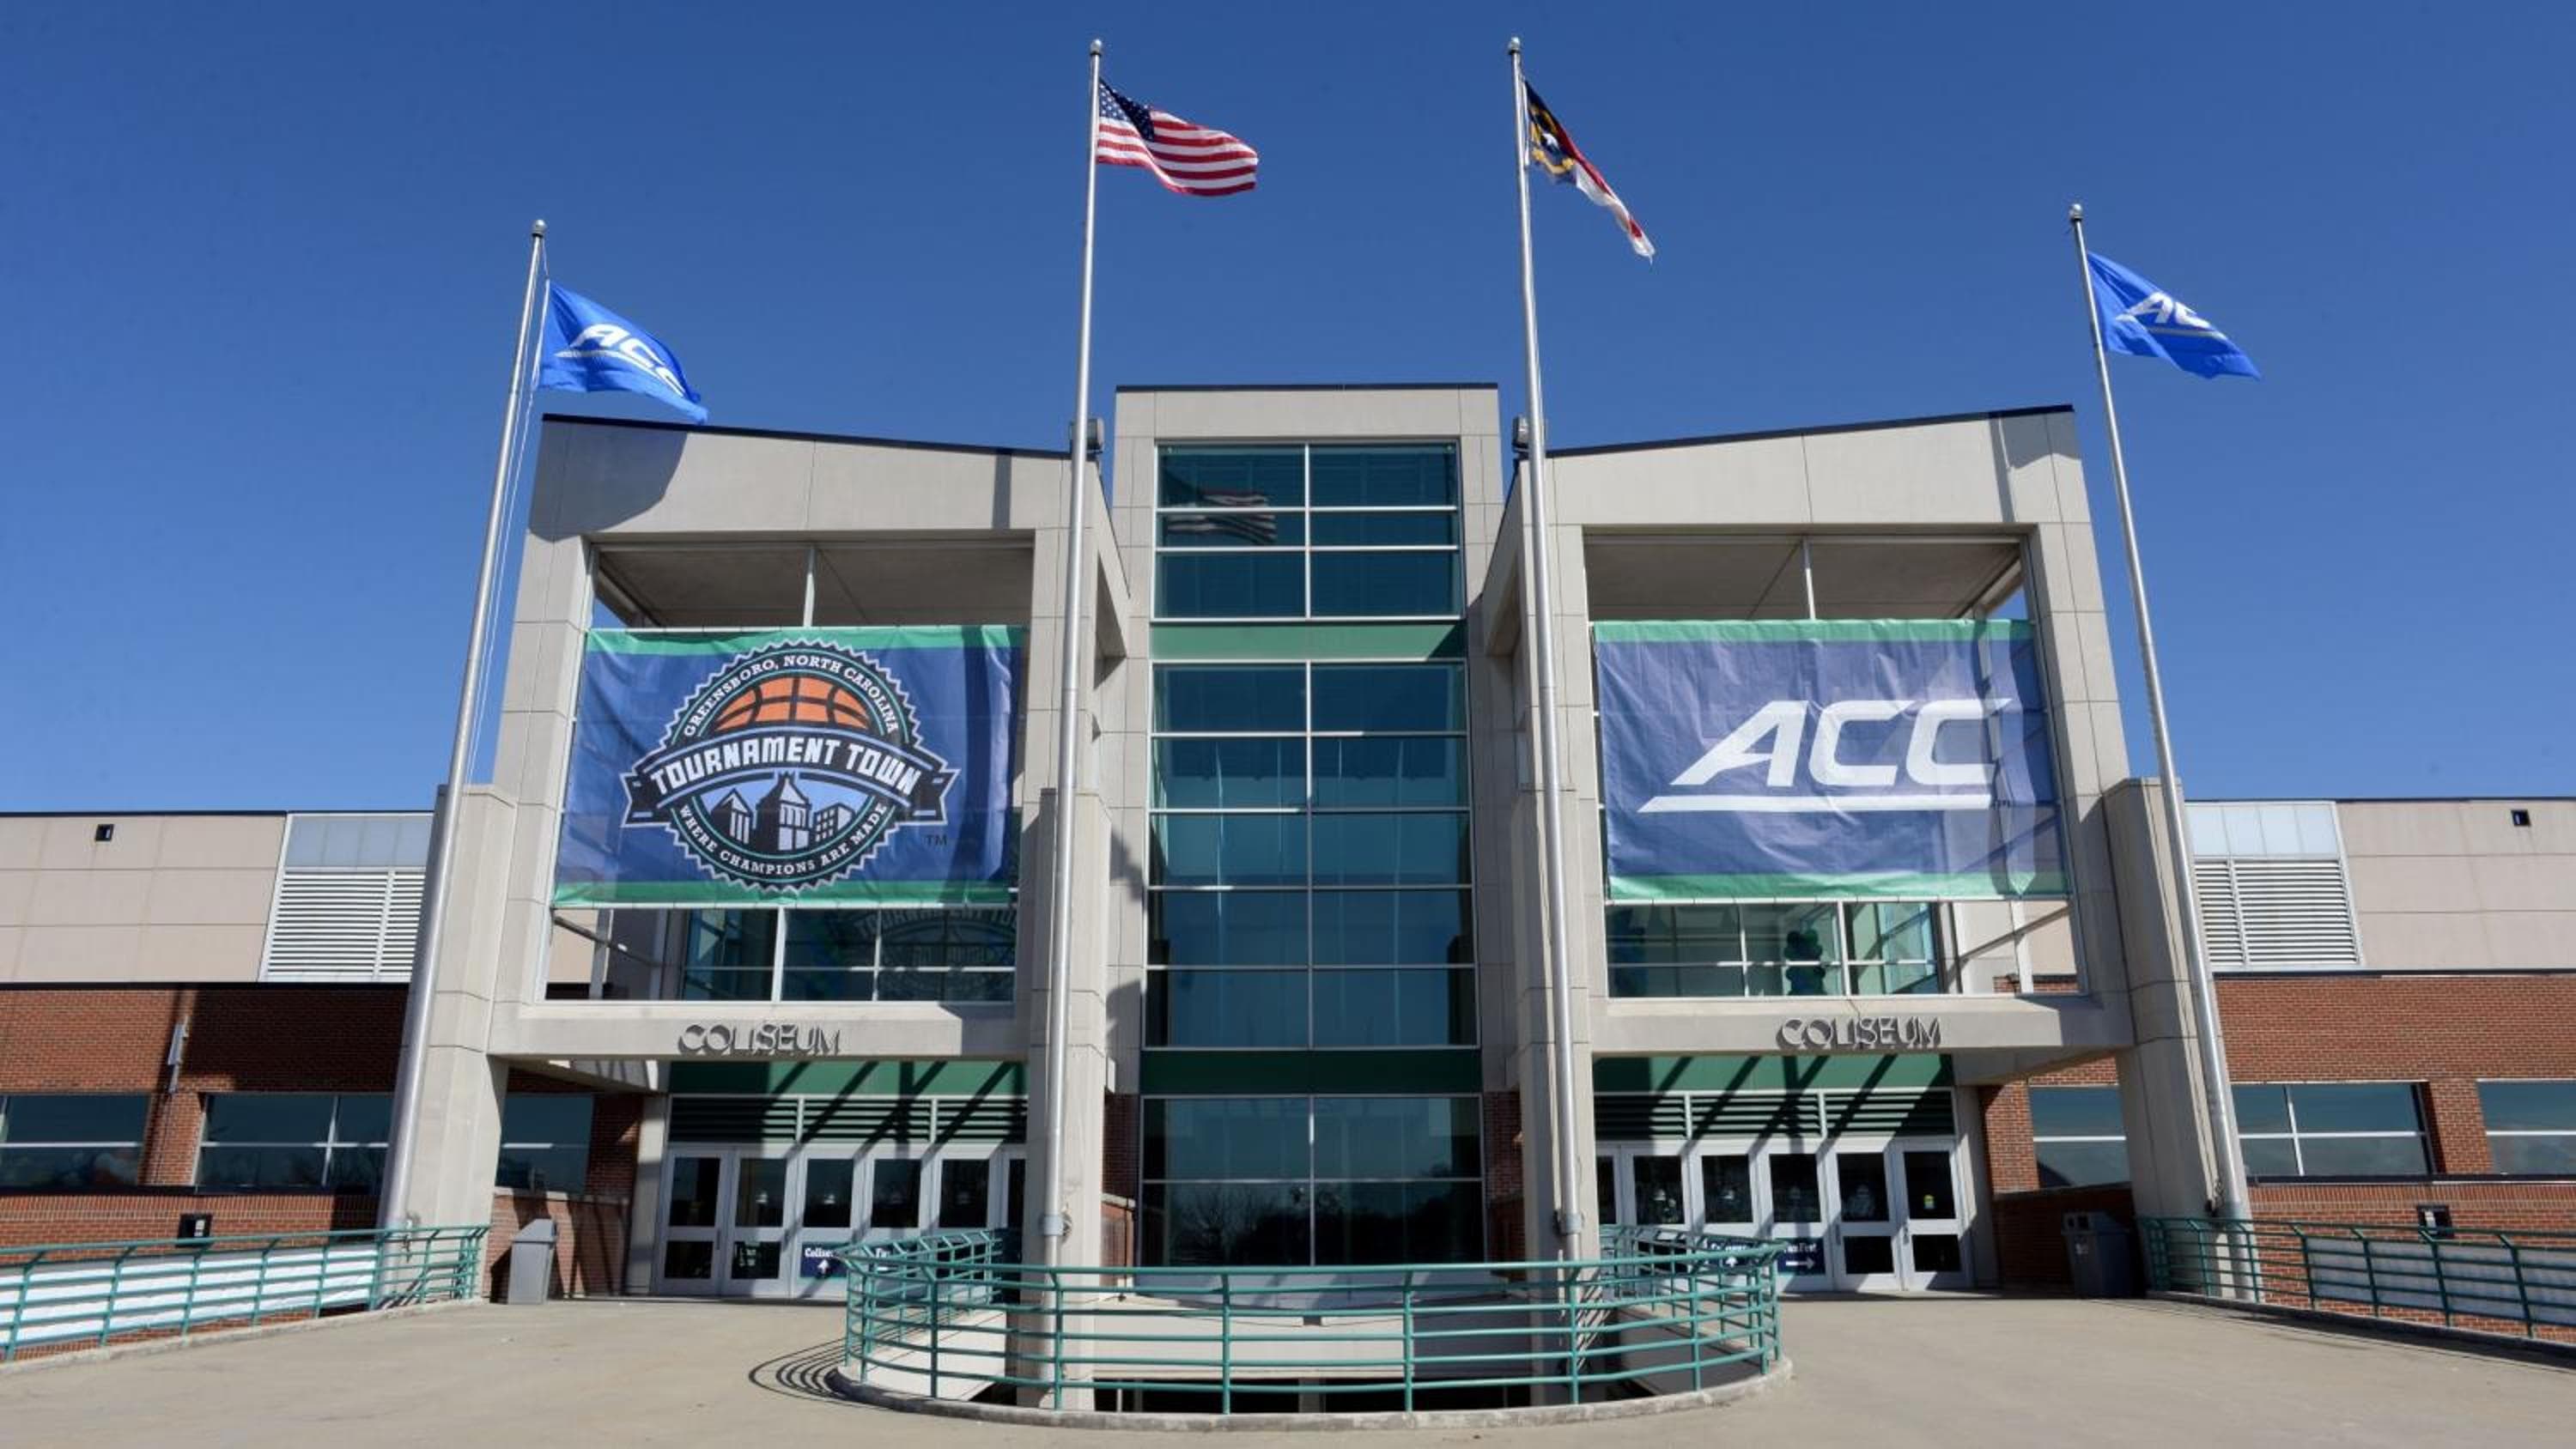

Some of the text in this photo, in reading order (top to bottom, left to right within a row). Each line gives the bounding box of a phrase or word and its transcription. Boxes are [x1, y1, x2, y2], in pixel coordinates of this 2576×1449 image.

[569, 324, 686, 397] ACC
[684, 655, 899, 737] GREENSBORO, NORTH CAROLINA
[650, 737, 921, 796] TOURNAMENT TOWN
[1670, 699, 2012, 787] ACC
[679, 803, 888, 876] WHERE CHAMPIONS ARE MADE
[926, 834, 947, 846] TM
[677, 1024, 841, 1055] COLISEUM
[1776, 1016, 1942, 1049] COLISEUM
